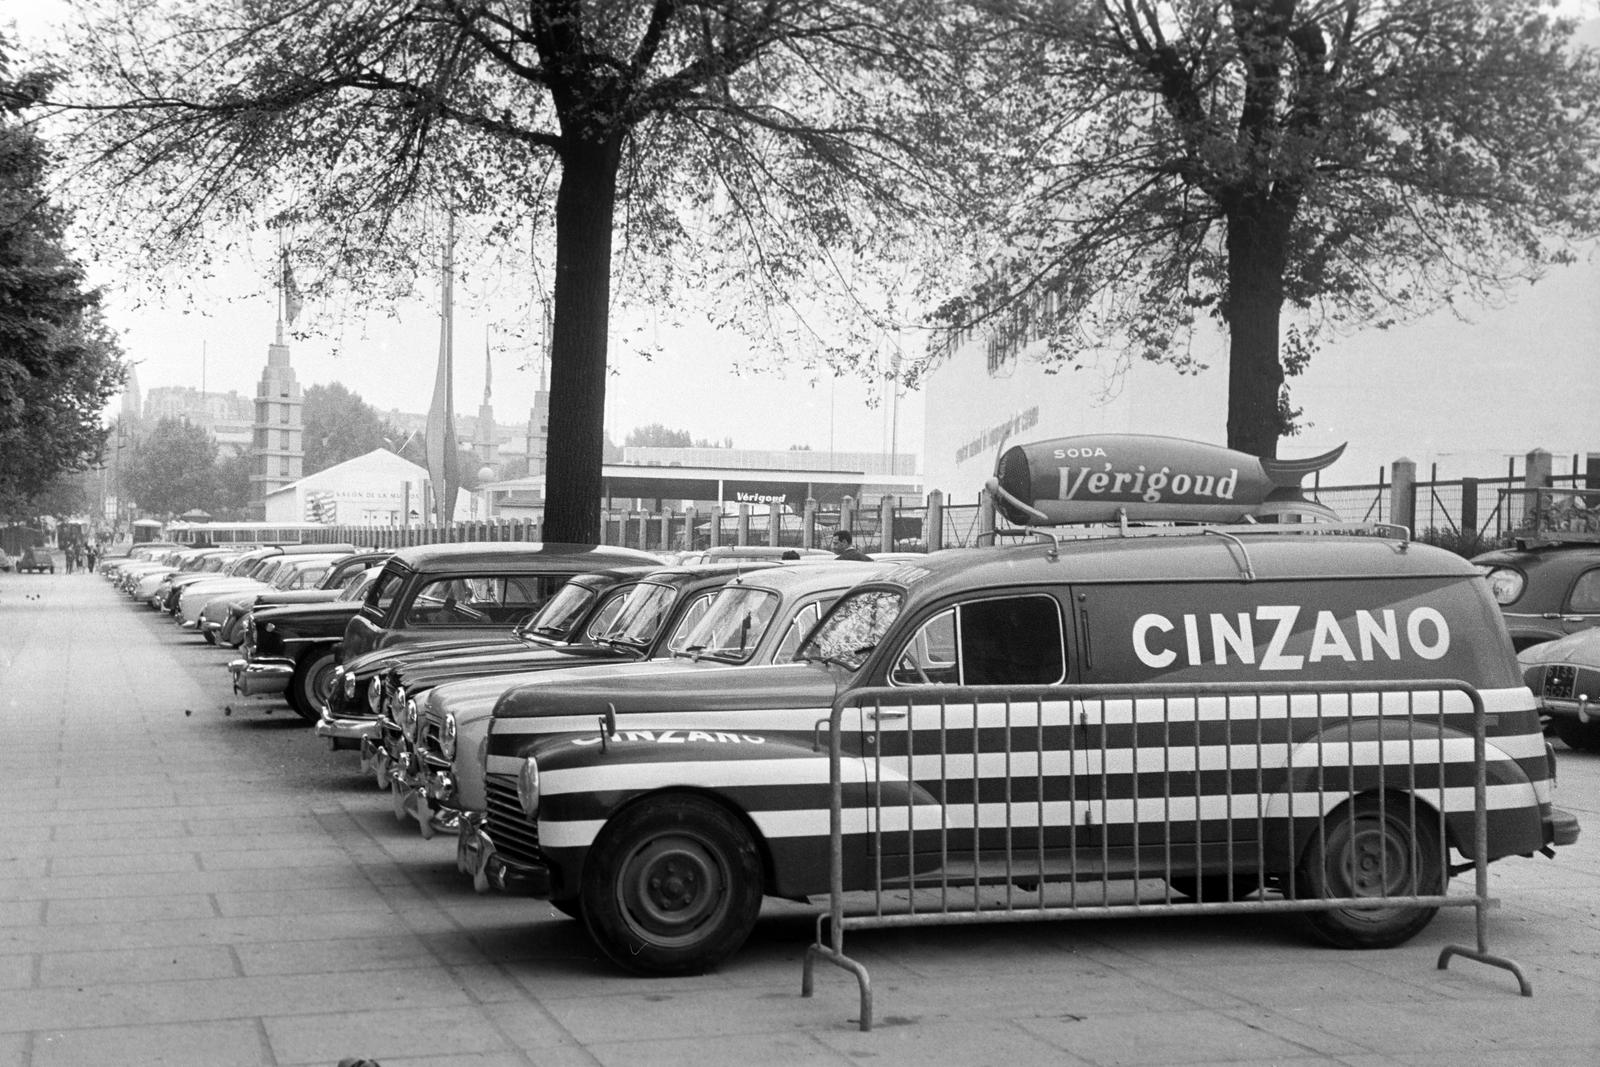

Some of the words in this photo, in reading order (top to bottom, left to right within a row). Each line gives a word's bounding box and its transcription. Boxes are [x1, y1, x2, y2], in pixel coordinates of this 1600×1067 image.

[1053, 447, 1107, 459] SODA
[1058, 462, 1239, 503] Vérigoud
[1132, 605, 1451, 671] CINZANO
